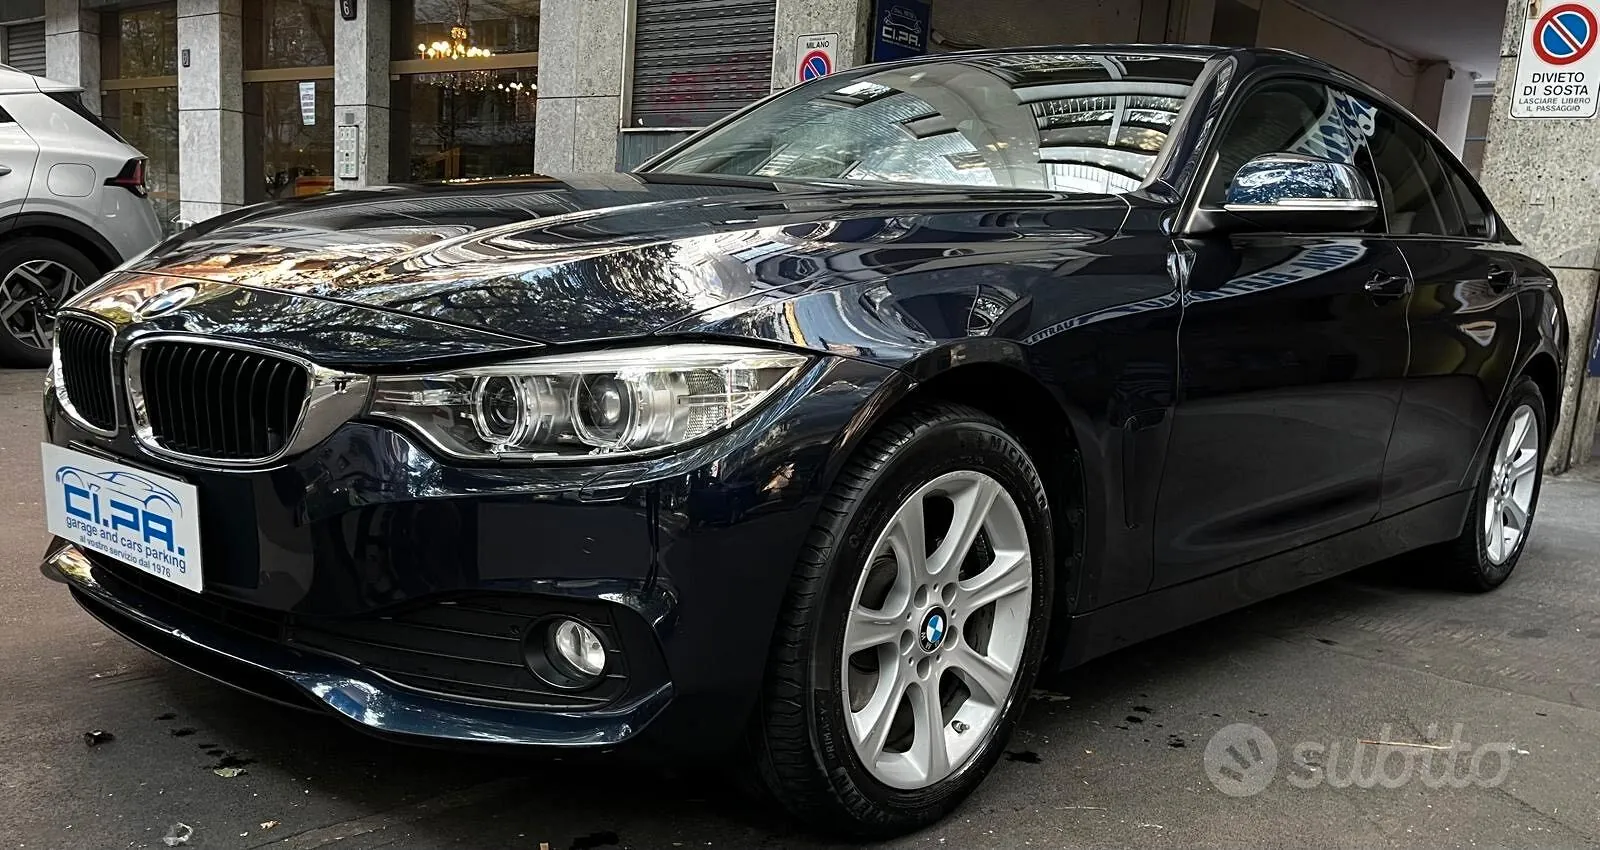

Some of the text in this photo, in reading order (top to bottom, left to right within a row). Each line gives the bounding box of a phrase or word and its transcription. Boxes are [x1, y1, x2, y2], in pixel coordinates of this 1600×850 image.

[343, 1, 350, 16] 6
[882, 25, 921, 47] CI.PA.
[806, 40, 830, 49] MILANO
[1531, 71, 1585, 83] DIVIETO
[1523, 84, 1589, 96] DI SOSTA
[1518, 97, 1558, 105] LASCIARE
[1536, 104, 1581, 112] PASSAGGIO
[990, 434, 1048, 509] MICHELIN
[63, 483, 186, 557] CI.PA.
[66, 516, 187, 574] garage and cars parking
[79, 534, 171, 578] al vostro servizio dal 1976
